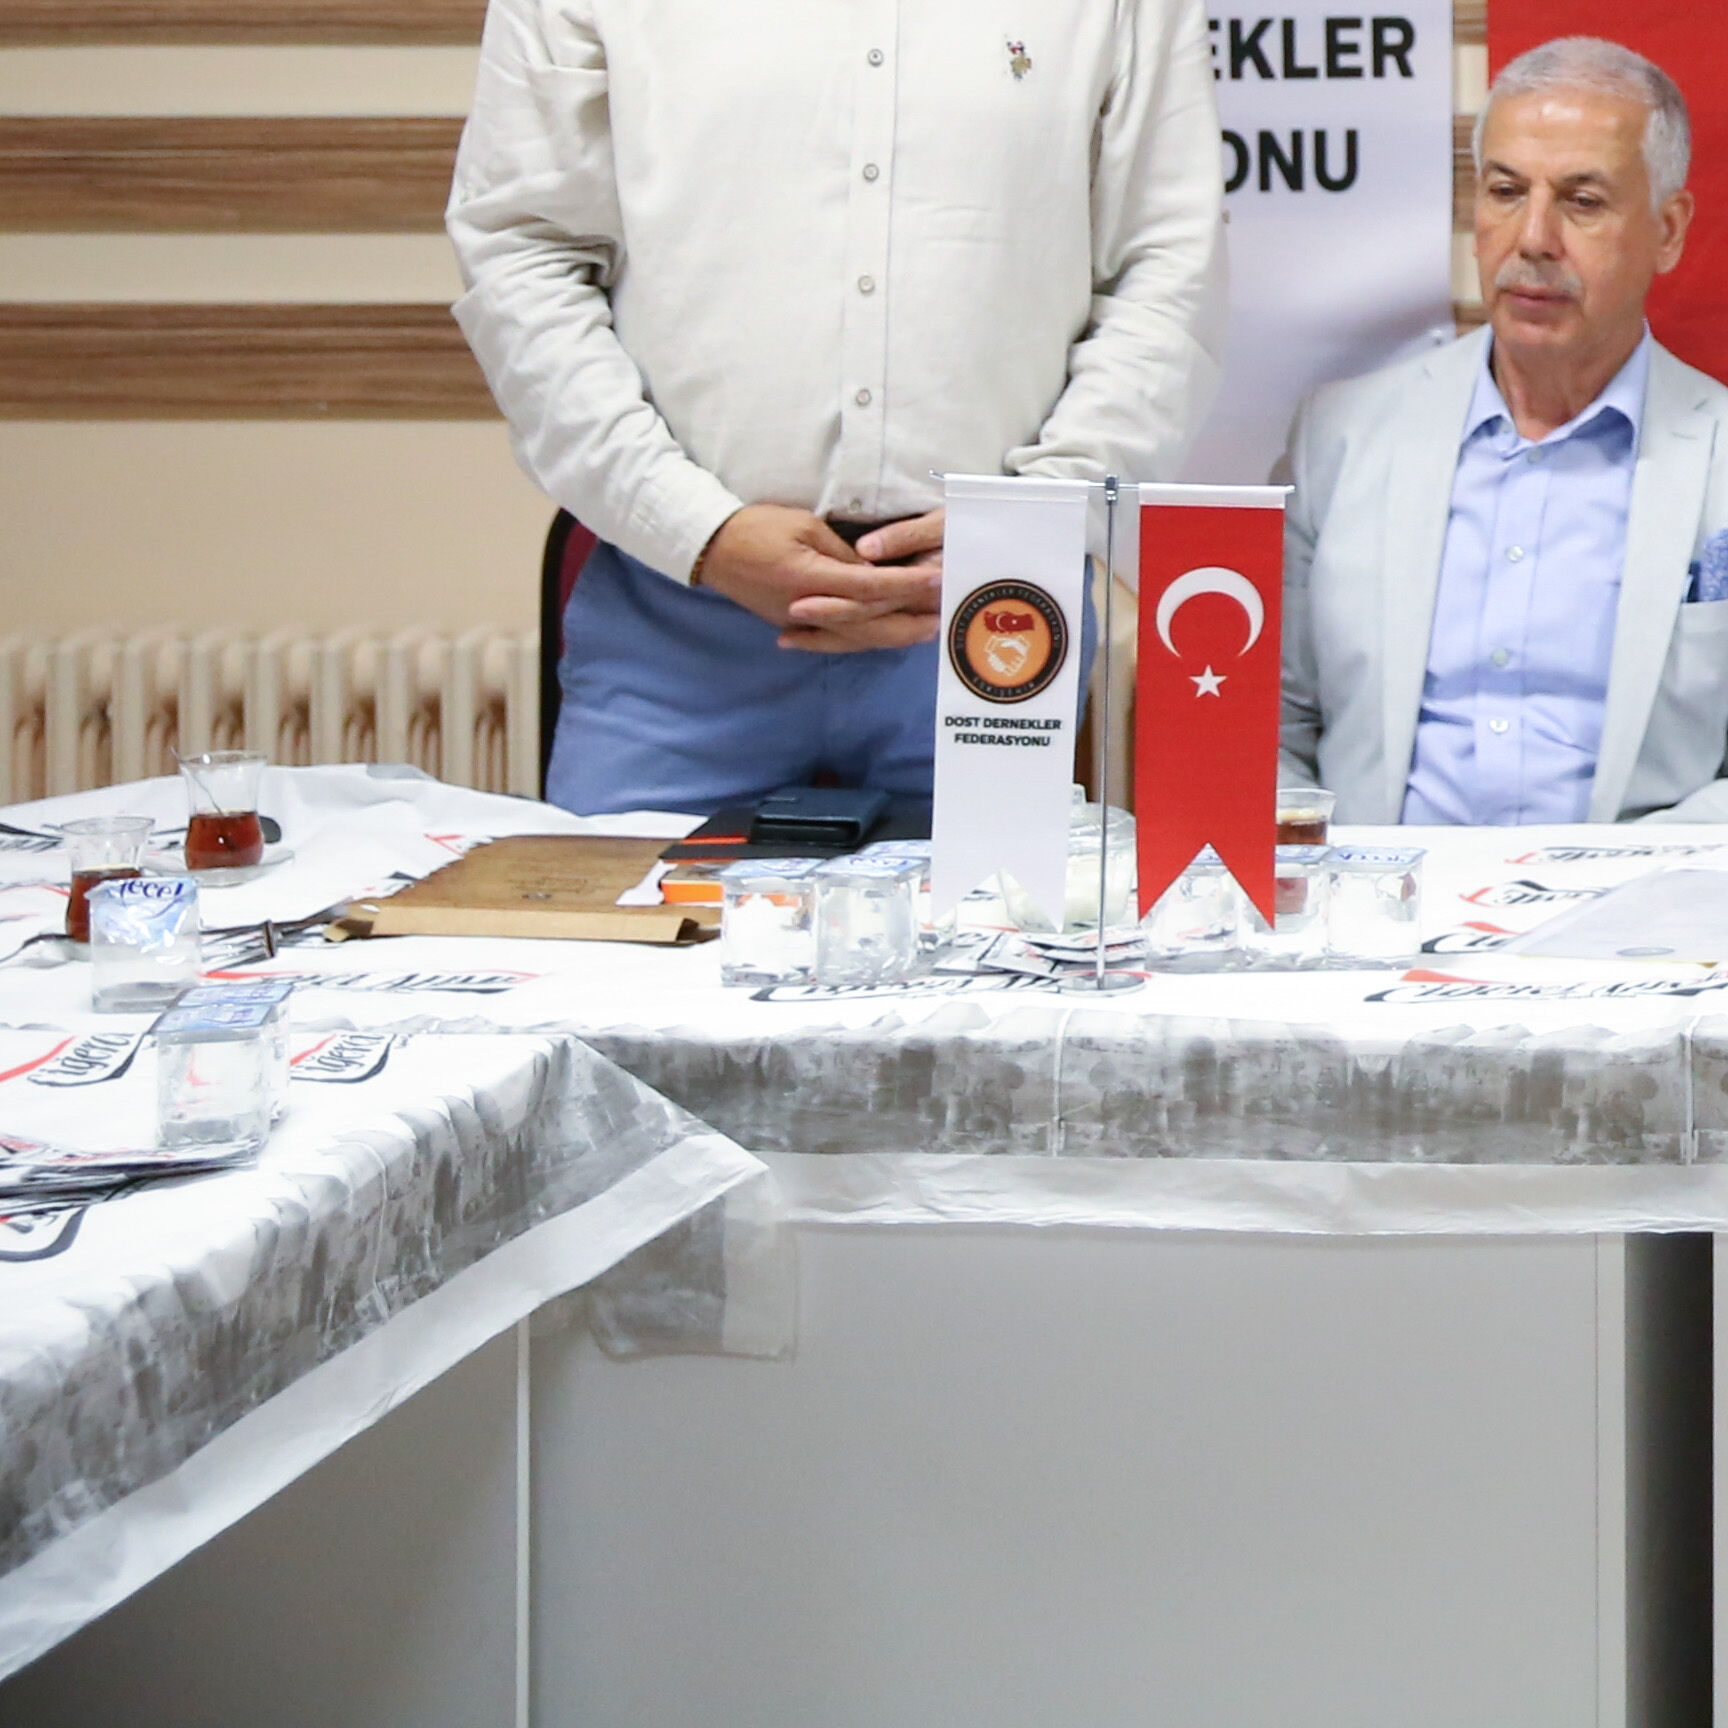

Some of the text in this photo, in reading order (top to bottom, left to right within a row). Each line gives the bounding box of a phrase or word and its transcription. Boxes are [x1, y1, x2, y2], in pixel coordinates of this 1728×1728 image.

[945, 716, 1062, 730] DOST DERNEKLER
[954, 733, 1051, 746] FEDERASYONU
